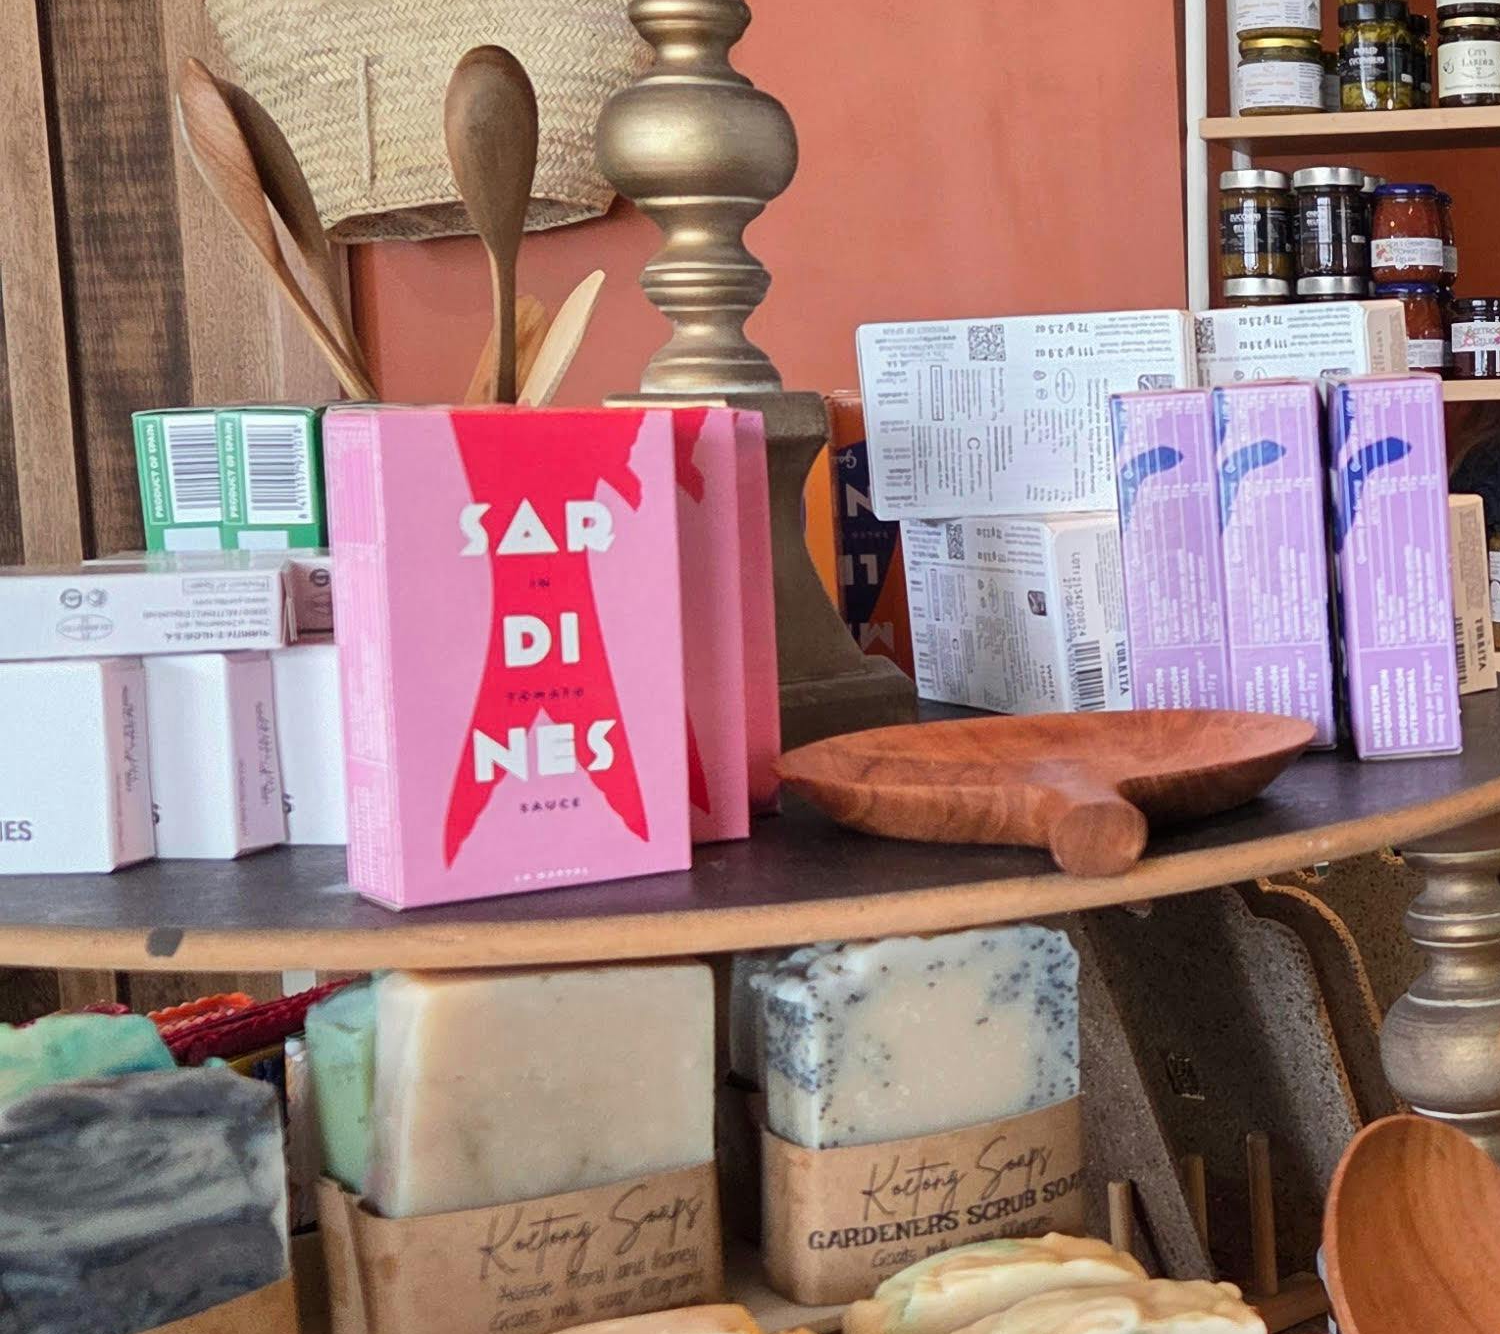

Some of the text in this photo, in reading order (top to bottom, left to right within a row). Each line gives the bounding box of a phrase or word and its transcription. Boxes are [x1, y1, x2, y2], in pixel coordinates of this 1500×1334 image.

[146, 423, 165, 519] PRODUCT OF SPAIN
[223, 422, 241, 519] PRODUCT OF SPAIN
[459, 497, 616, 557] SAR
[528, 577, 551, 589] IN
[502, 611, 580, 668] DI
[505, 687, 585, 703] TOMATO
[473, 719, 616, 784] NES
[519, 797, 582, 814] SAUCE
[808, 1188, 1037, 1251] GARDENERS SCRUB
